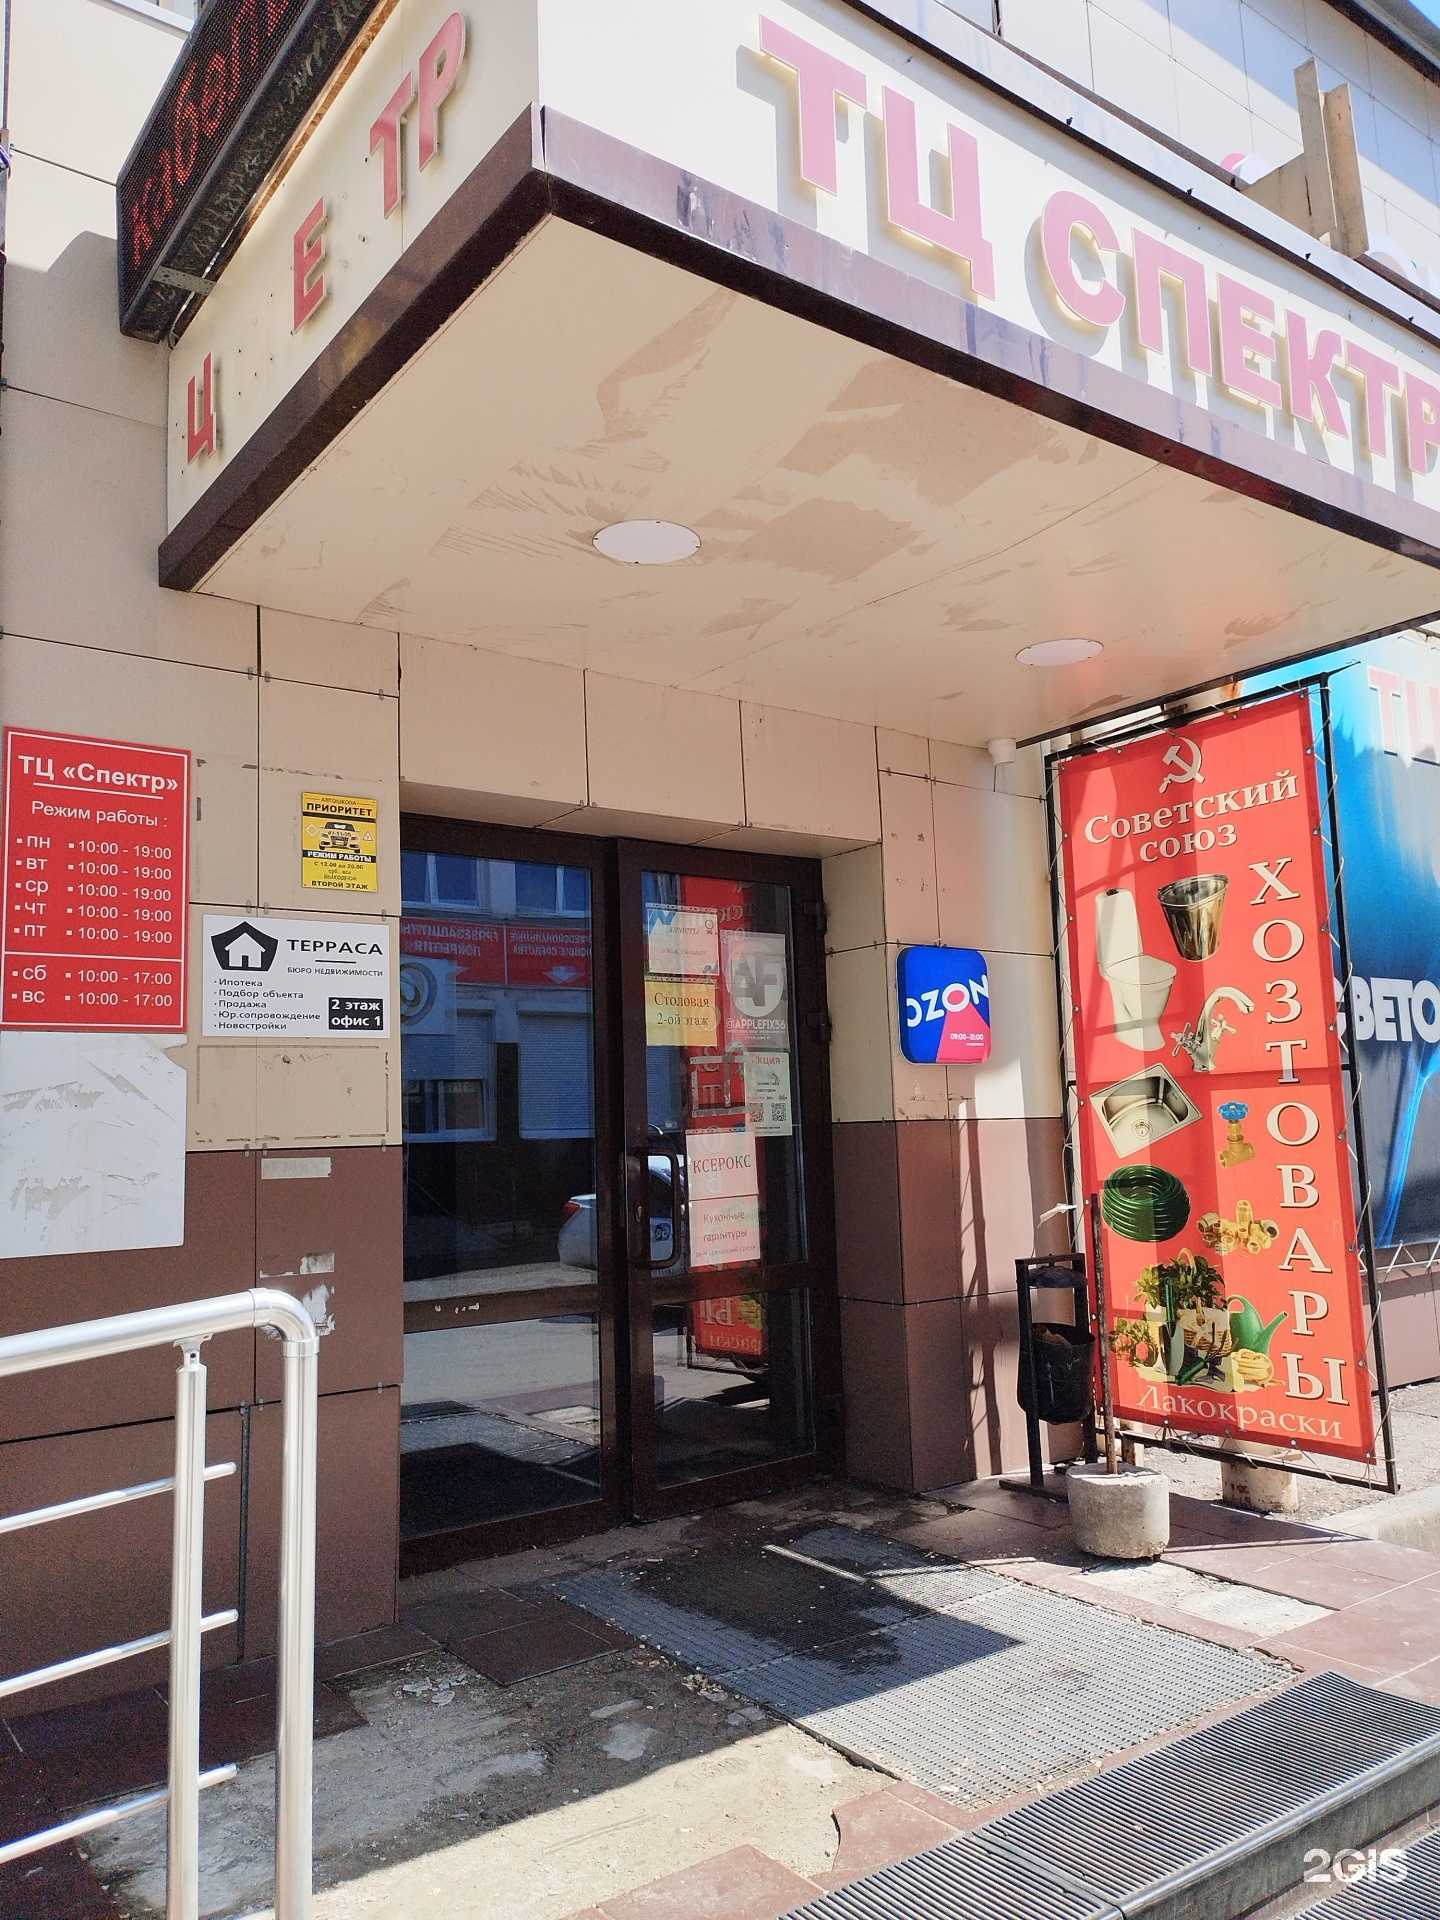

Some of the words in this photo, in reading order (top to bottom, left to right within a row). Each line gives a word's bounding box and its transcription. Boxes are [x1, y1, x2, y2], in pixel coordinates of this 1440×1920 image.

[759, 14, 996, 301] ТЦ
[1040, 189, 1440, 475] СПЕКТР
[18, 755, 55, 781] ТЦ
[63, 763, 179, 793] «Спектр»
[32, 800, 91, 820] Режим
[96, 810, 158, 826] работы
[306, 802, 373, 817] ПРИОРИТЕТ
[1084, 769, 1299, 846] Советский
[27, 836, 51, 848] пн
[80, 841, 118, 855] 10:00
[135, 846, 172, 860] 19:00
[307, 850, 337, 860] РЕЖИМ
[338, 853, 372, 863] РАБОТЫ
[26, 858, 48, 870] вт
[79, 862, 118, 876] 10:00
[135, 867, 172, 881] 19:00
[25, 879, 49, 896] ср
[78, 883, 118, 897] 10:00
[134, 888, 171, 901] 19:00
[311, 880, 344, 889] ВТОРОЙ
[345, 882, 369, 890] ЭТАЖ
[25, 902, 47, 915] чт
[78, 905, 119, 919] 10:00
[135, 909, 172, 922] 19:00
[24, 924, 48, 937] пт
[79, 927, 119, 941] 10:00
[135, 930, 173, 944] 19:00
[287, 939, 383, 956] ТЕРРАСА
[22, 964, 47, 981] сб
[78, 969, 118, 983] 10:00
[134, 971, 172, 985] 17:00
[287, 966, 312, 975] БЮРО
[315, 967, 383, 977] НЕДВИЖИМОСТИ
[218, 978, 263, 988] Ипотека
[22, 990, 46, 1003] вс
[79, 992, 119, 1006] 10:00
[135, 993, 173, 1007] 17:00
[218, 989, 259, 999] Подбор
[262, 990, 304, 999] объекта
[654, 993, 711, 1008] Столовая
[218, 1000, 267, 1010] Продажа
[331, 999, 341, 1011] 2
[345, 1000, 381, 1012] этаж
[218, 1022, 287, 1031] Новостройки
[331, 1018, 370, 1029] офис
[374, 1015, 381, 1027] 1
[657, 1012, 681, 1025] 2-ой
[1248, 857, 1350, 1406] ХОЗТОВАРЫ
[693, 1154, 752, 1174] КСЕРОКС
[703, 1212, 745, 1225] Кухонные
[1136, 1384, 1342, 1440] Лакокраски
